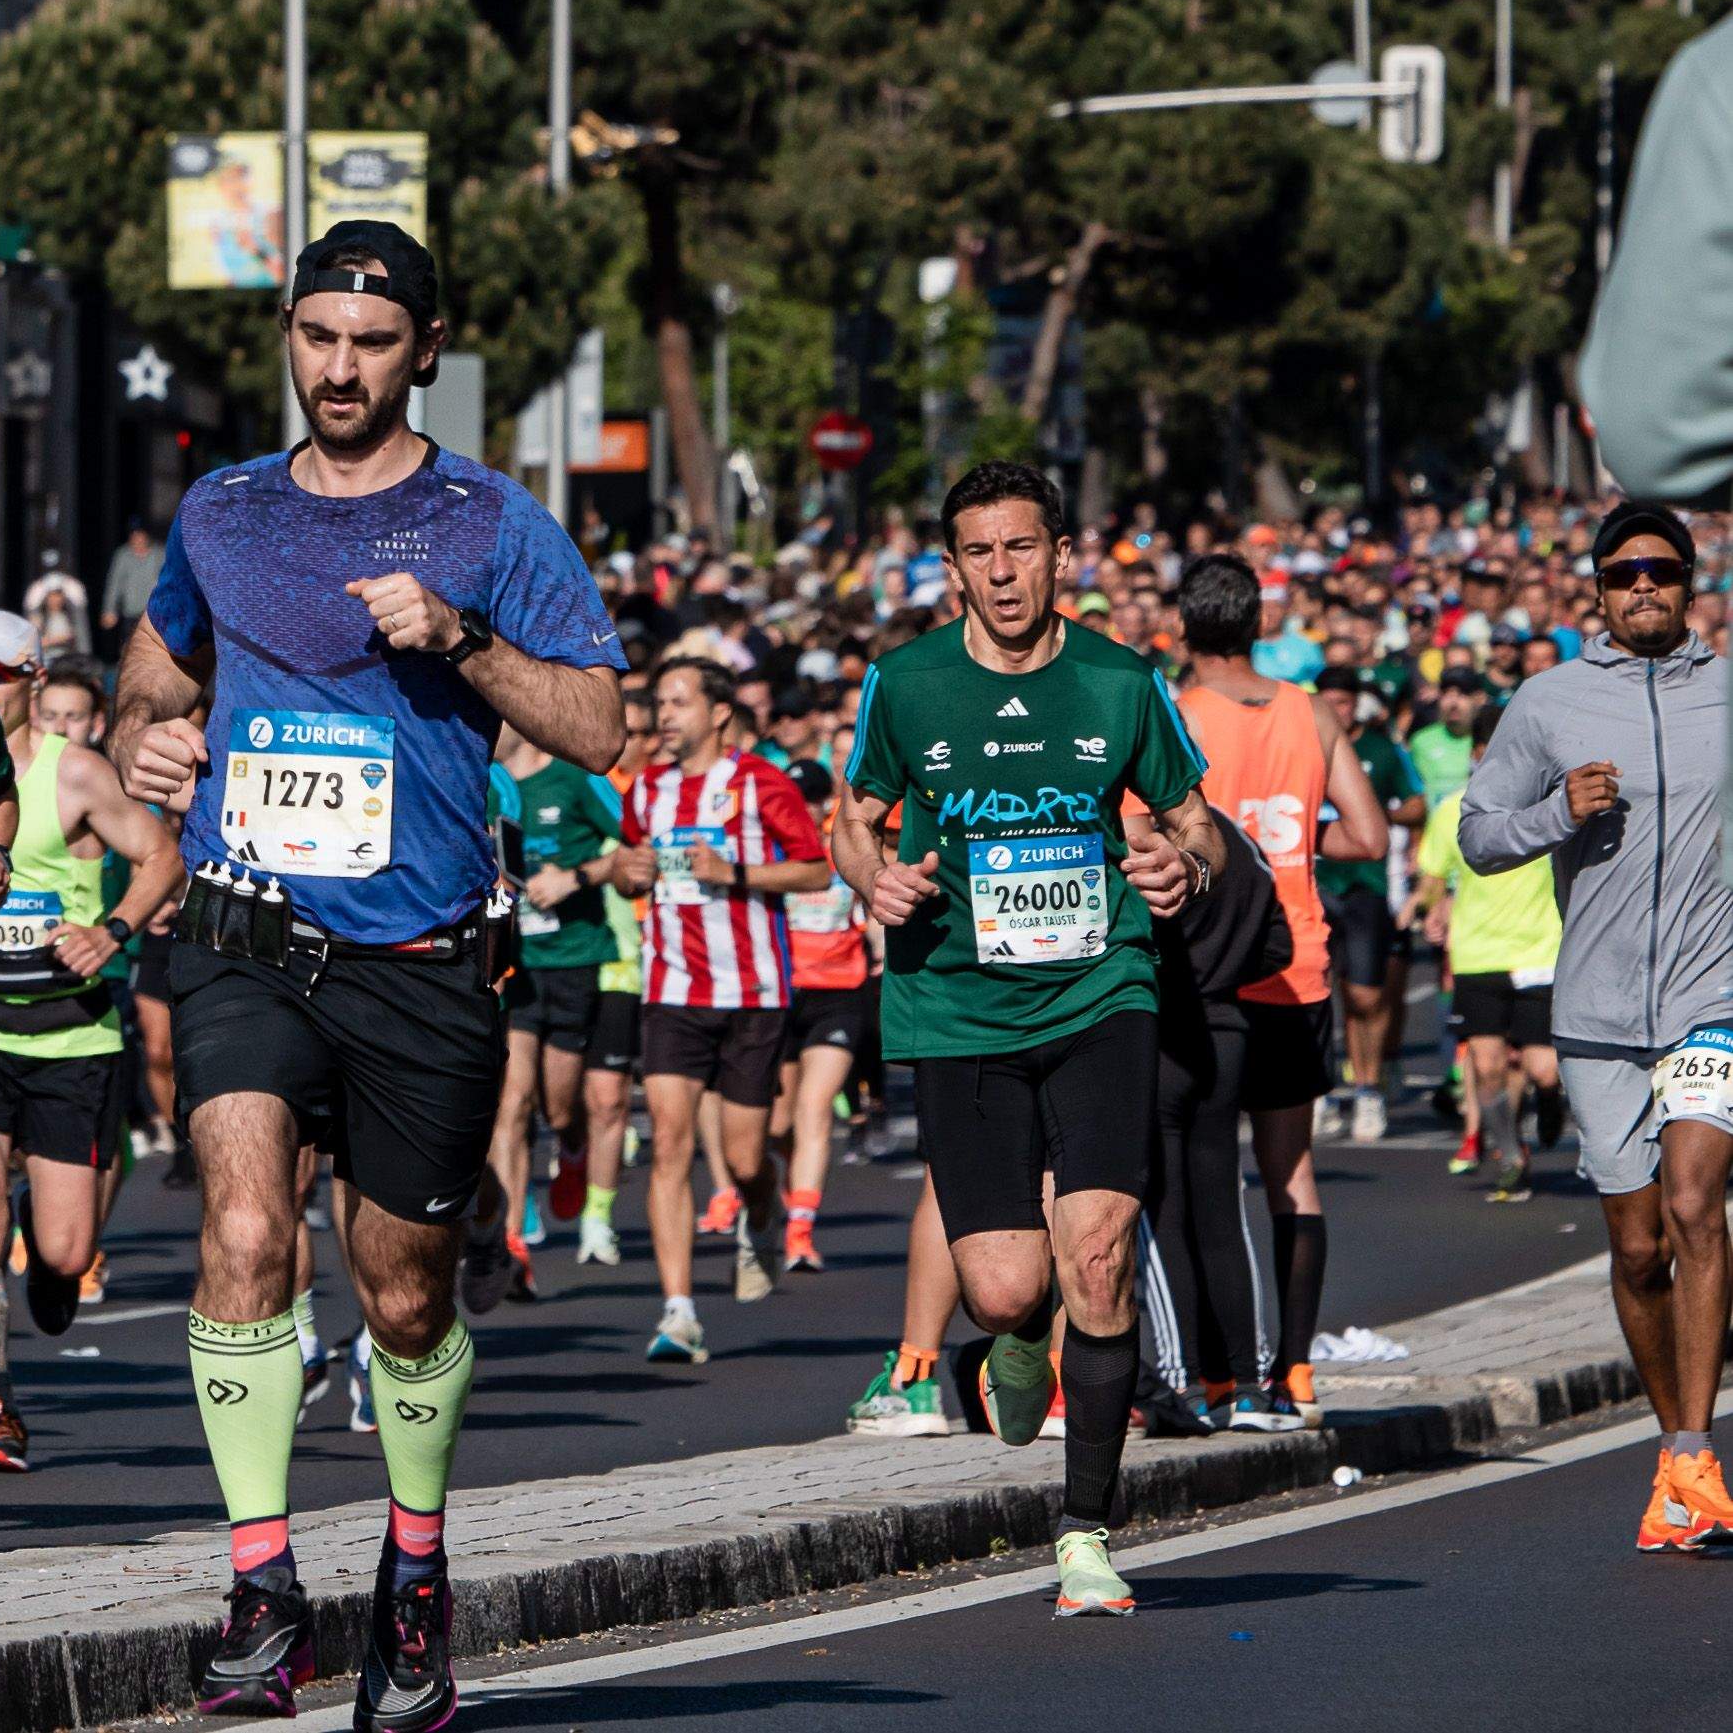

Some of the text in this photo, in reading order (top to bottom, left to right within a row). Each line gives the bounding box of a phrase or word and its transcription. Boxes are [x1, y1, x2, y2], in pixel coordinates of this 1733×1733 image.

[281, 724, 366, 746] ZURICH
[1003, 742, 1044, 753] ZURICH
[262, 769, 344, 810] 1273
[938, 786, 1100, 827] MADRID
[1028, 826, 1079, 835] MARATHON
[1020, 845, 1084, 864] ZURICH
[994, 879, 1081, 914] 26000
[1009, 914, 1077, 929] ÓSCAR TAUSTE
[1692, 1031, 1733, 1046] ZURI
[1673, 1057, 1732, 1080] 2654
[1682, 1081, 1715, 1090] GABRIEL
